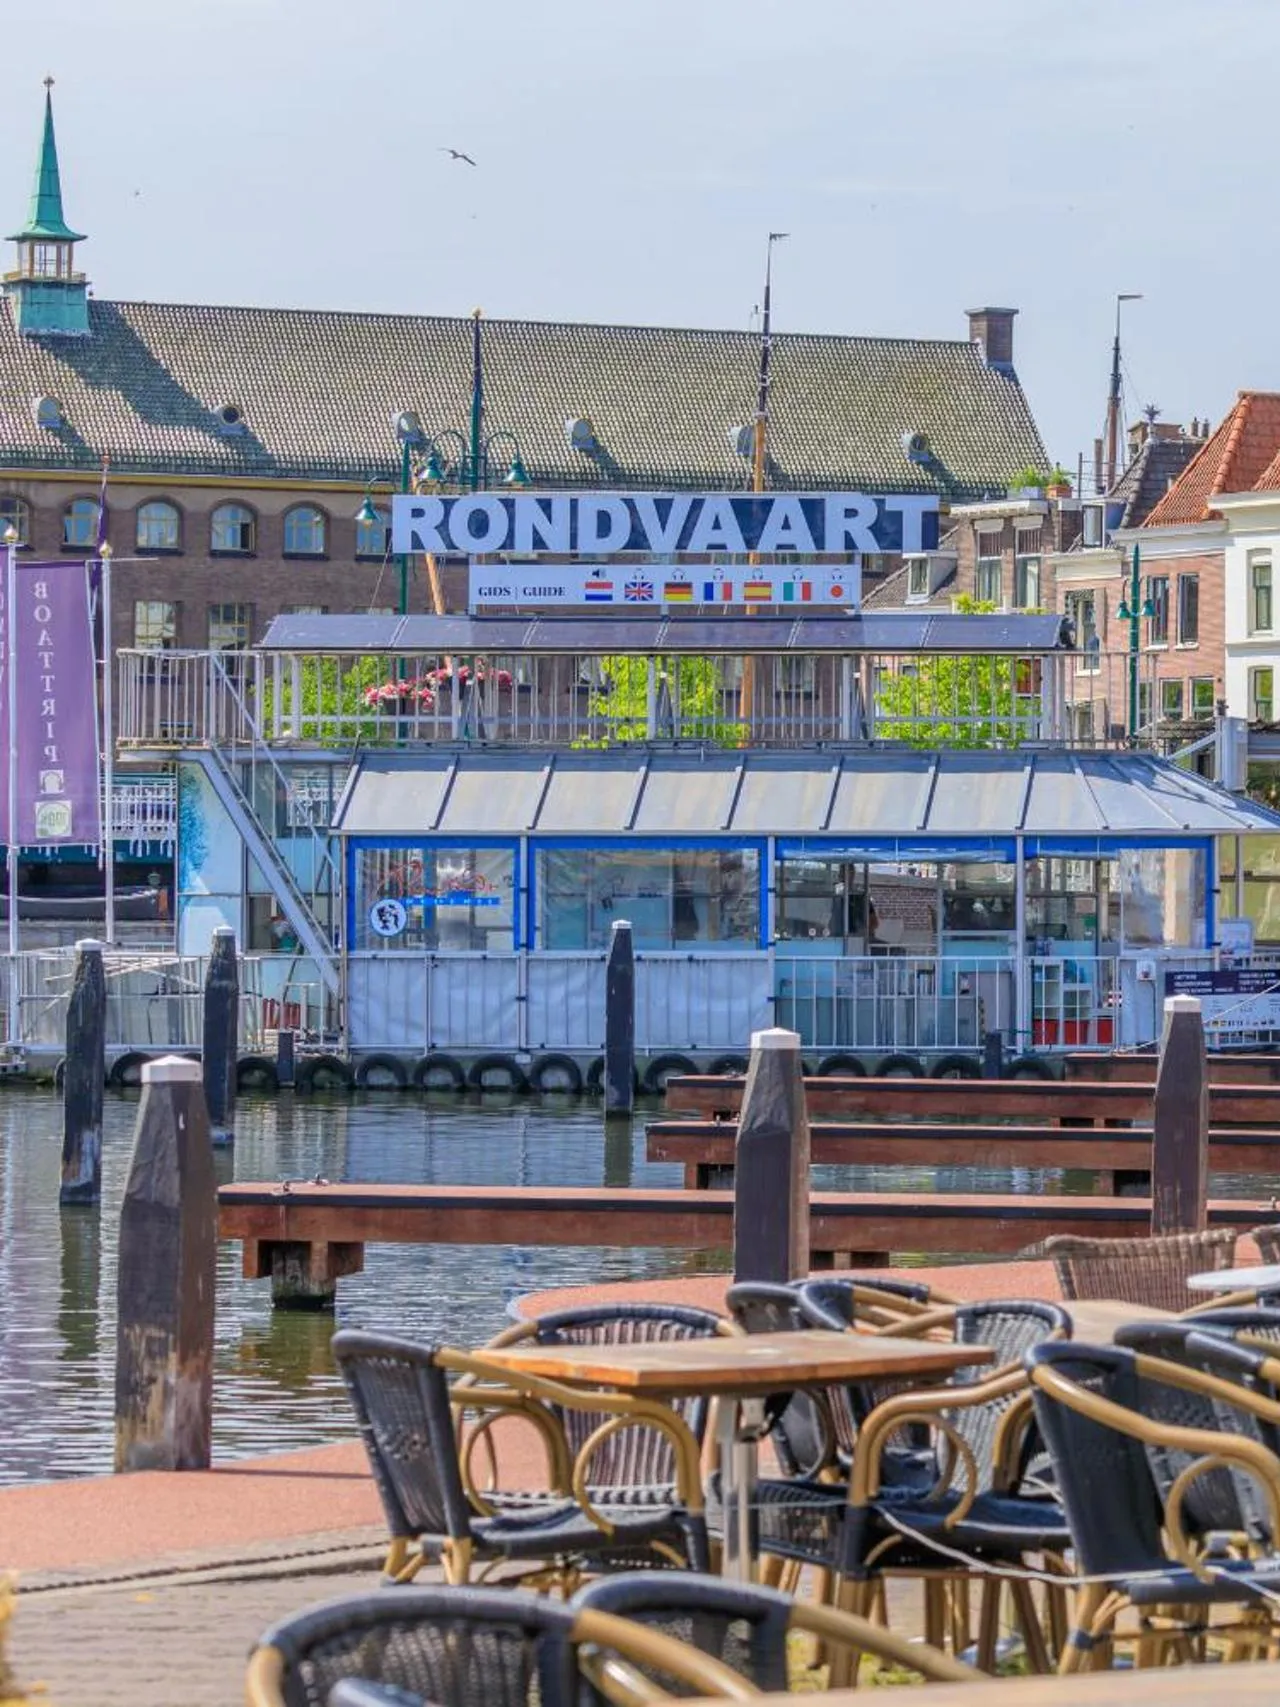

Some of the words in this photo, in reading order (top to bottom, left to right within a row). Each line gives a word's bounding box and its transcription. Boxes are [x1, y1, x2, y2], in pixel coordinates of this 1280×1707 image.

[392, 494, 940, 553] RONDVAART
[478, 586, 511, 597] GIDS
[522, 586, 566, 597] GUIDE
